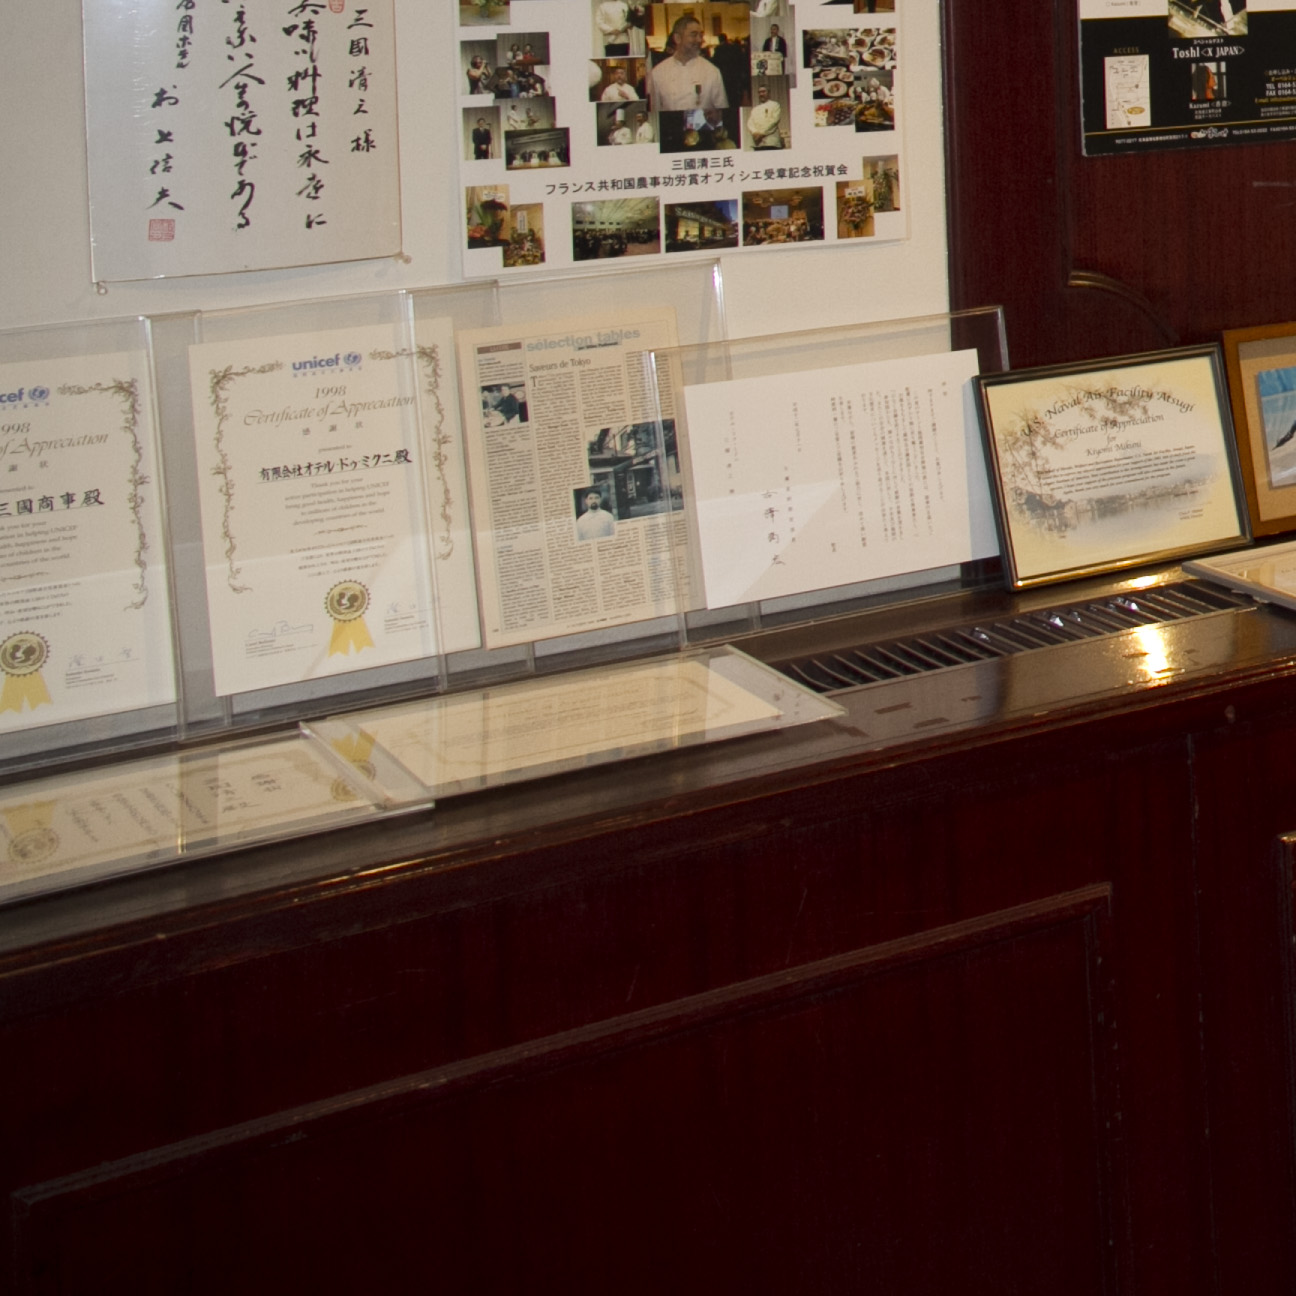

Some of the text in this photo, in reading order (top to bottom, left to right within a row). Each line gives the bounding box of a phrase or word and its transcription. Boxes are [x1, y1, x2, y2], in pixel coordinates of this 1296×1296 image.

[672, 156, 735, 171] 三國清三氏
[291, 354, 341, 372] unicef
[559, 360, 570, 368] de
[570, 357, 592, 367] Tokyo
[315, 385, 347, 399] 1998
[1106, 384, 1154, 401] Facility
[1156, 390, 1196, 414] Atsugi
[1, 422, 31, 435] 998
[1054, 423, 1099, 441] Certificate
